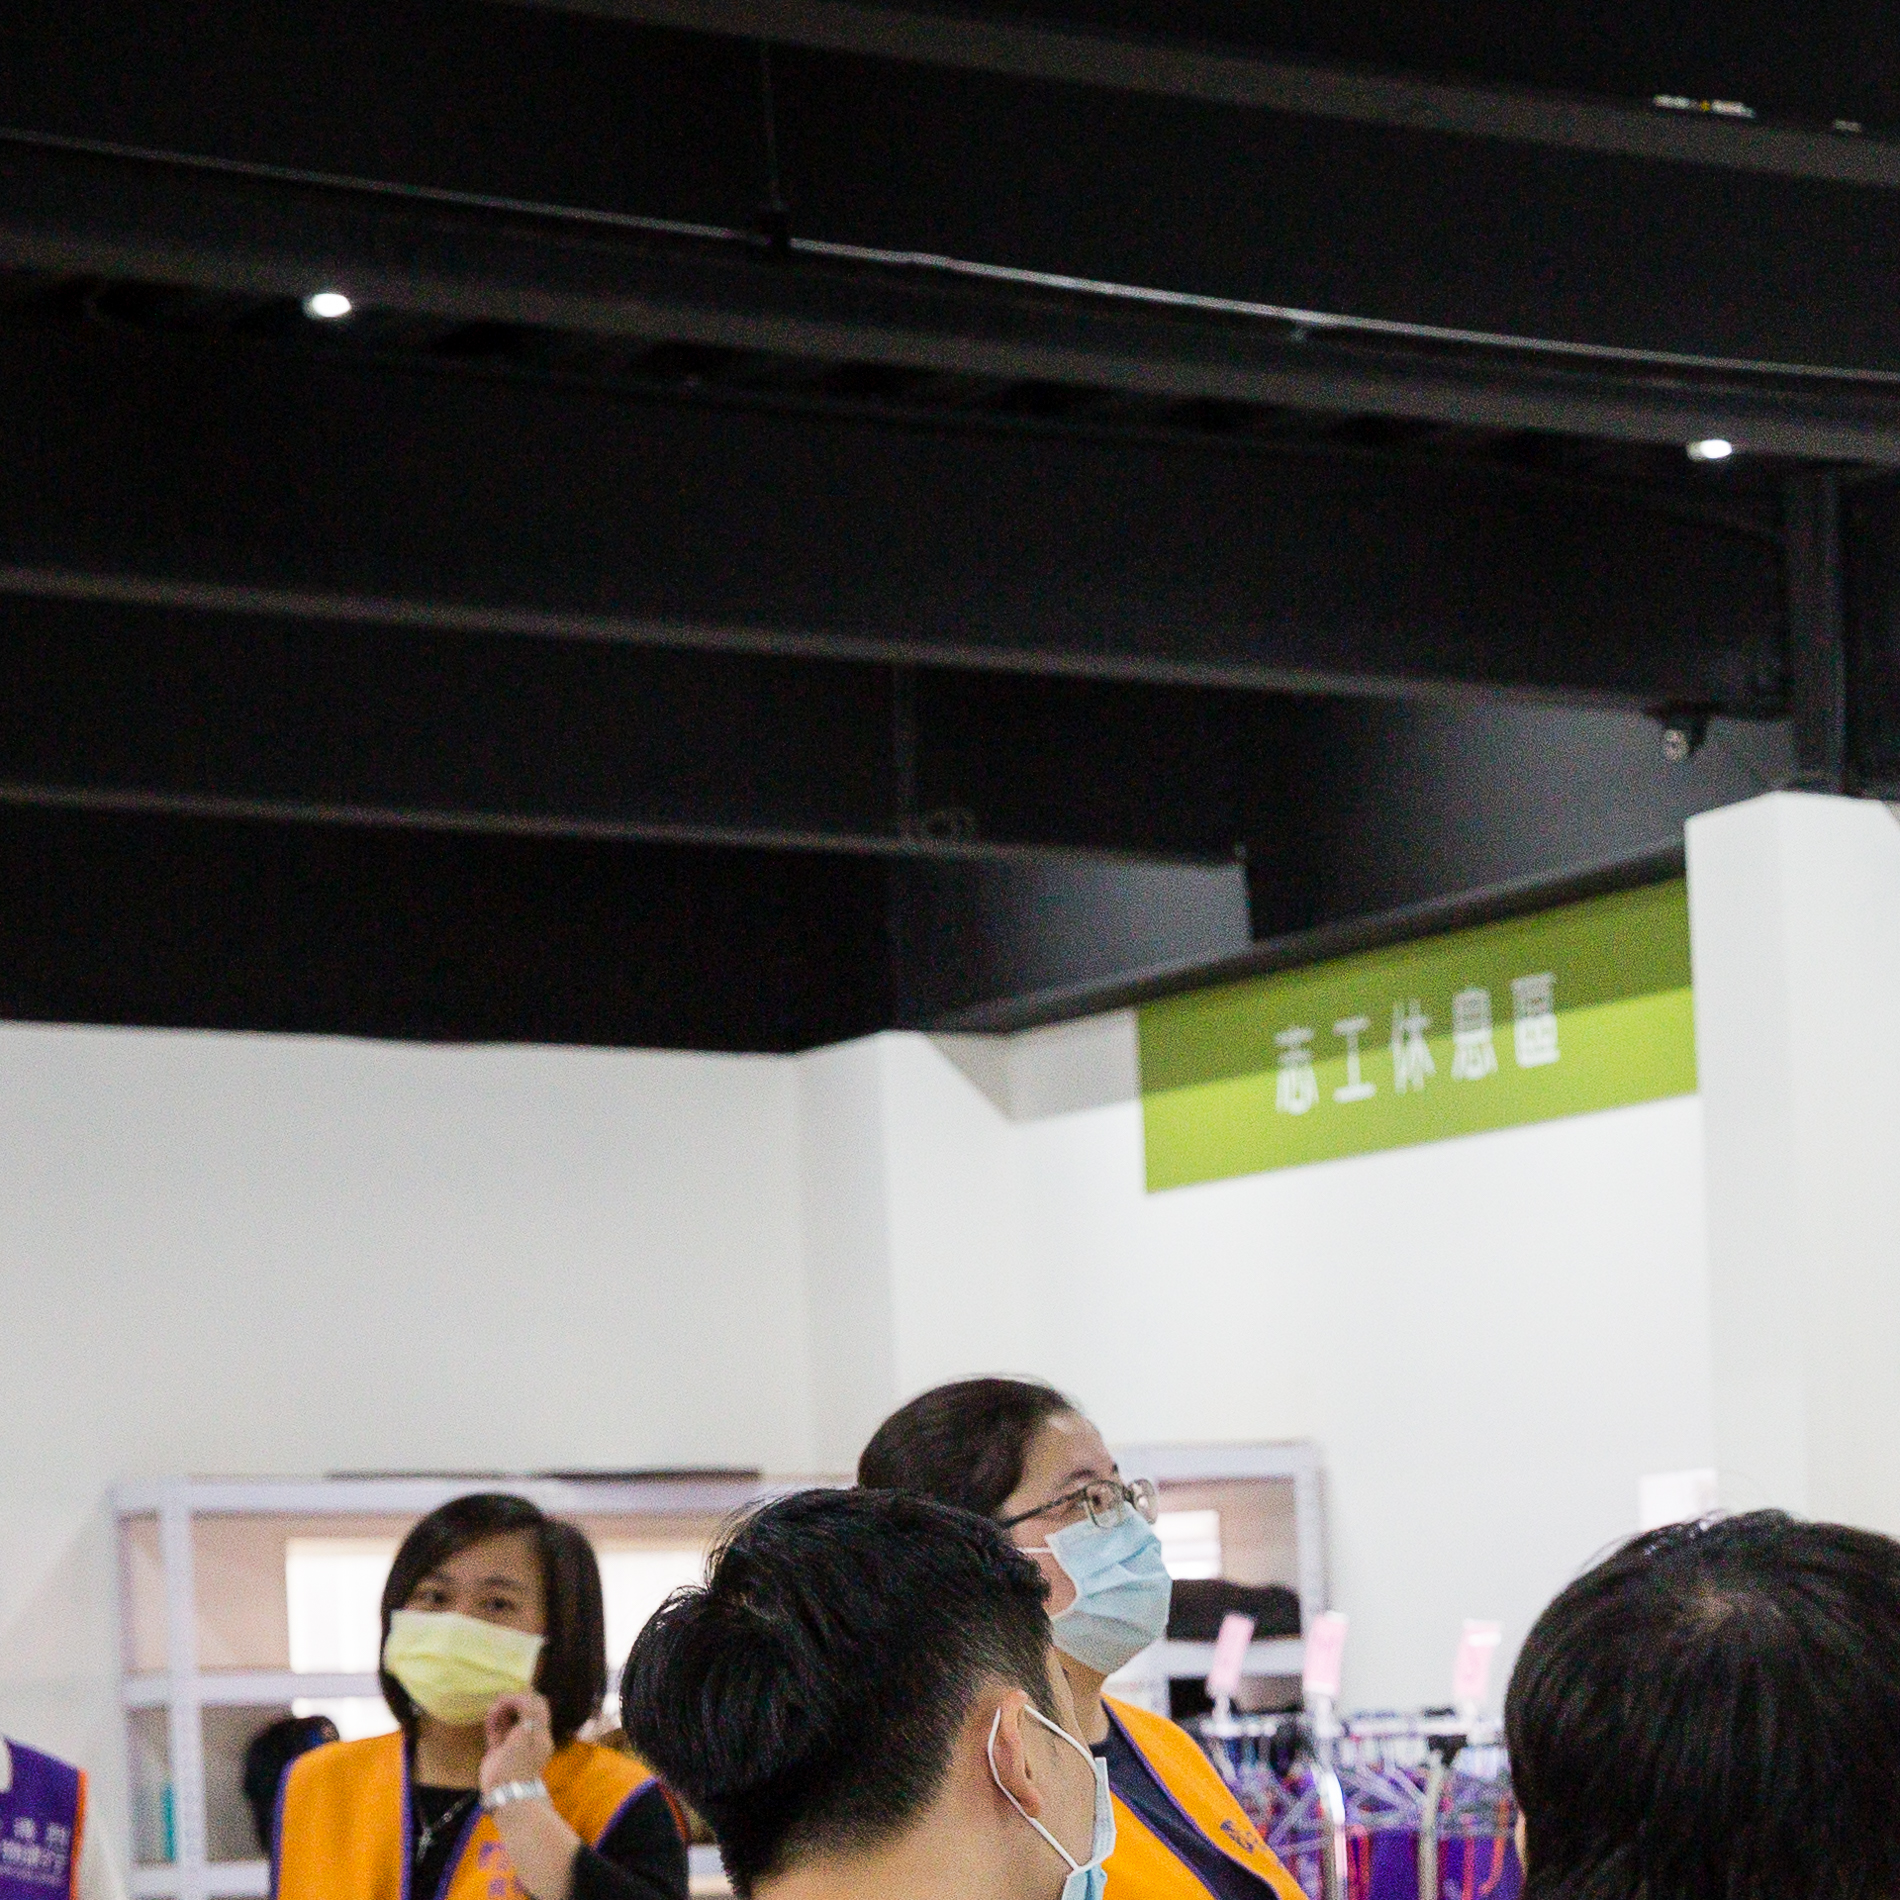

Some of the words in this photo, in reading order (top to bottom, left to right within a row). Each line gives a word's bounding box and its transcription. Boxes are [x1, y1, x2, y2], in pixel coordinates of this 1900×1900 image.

[1273, 971, 1561, 1116] 志工休息區
